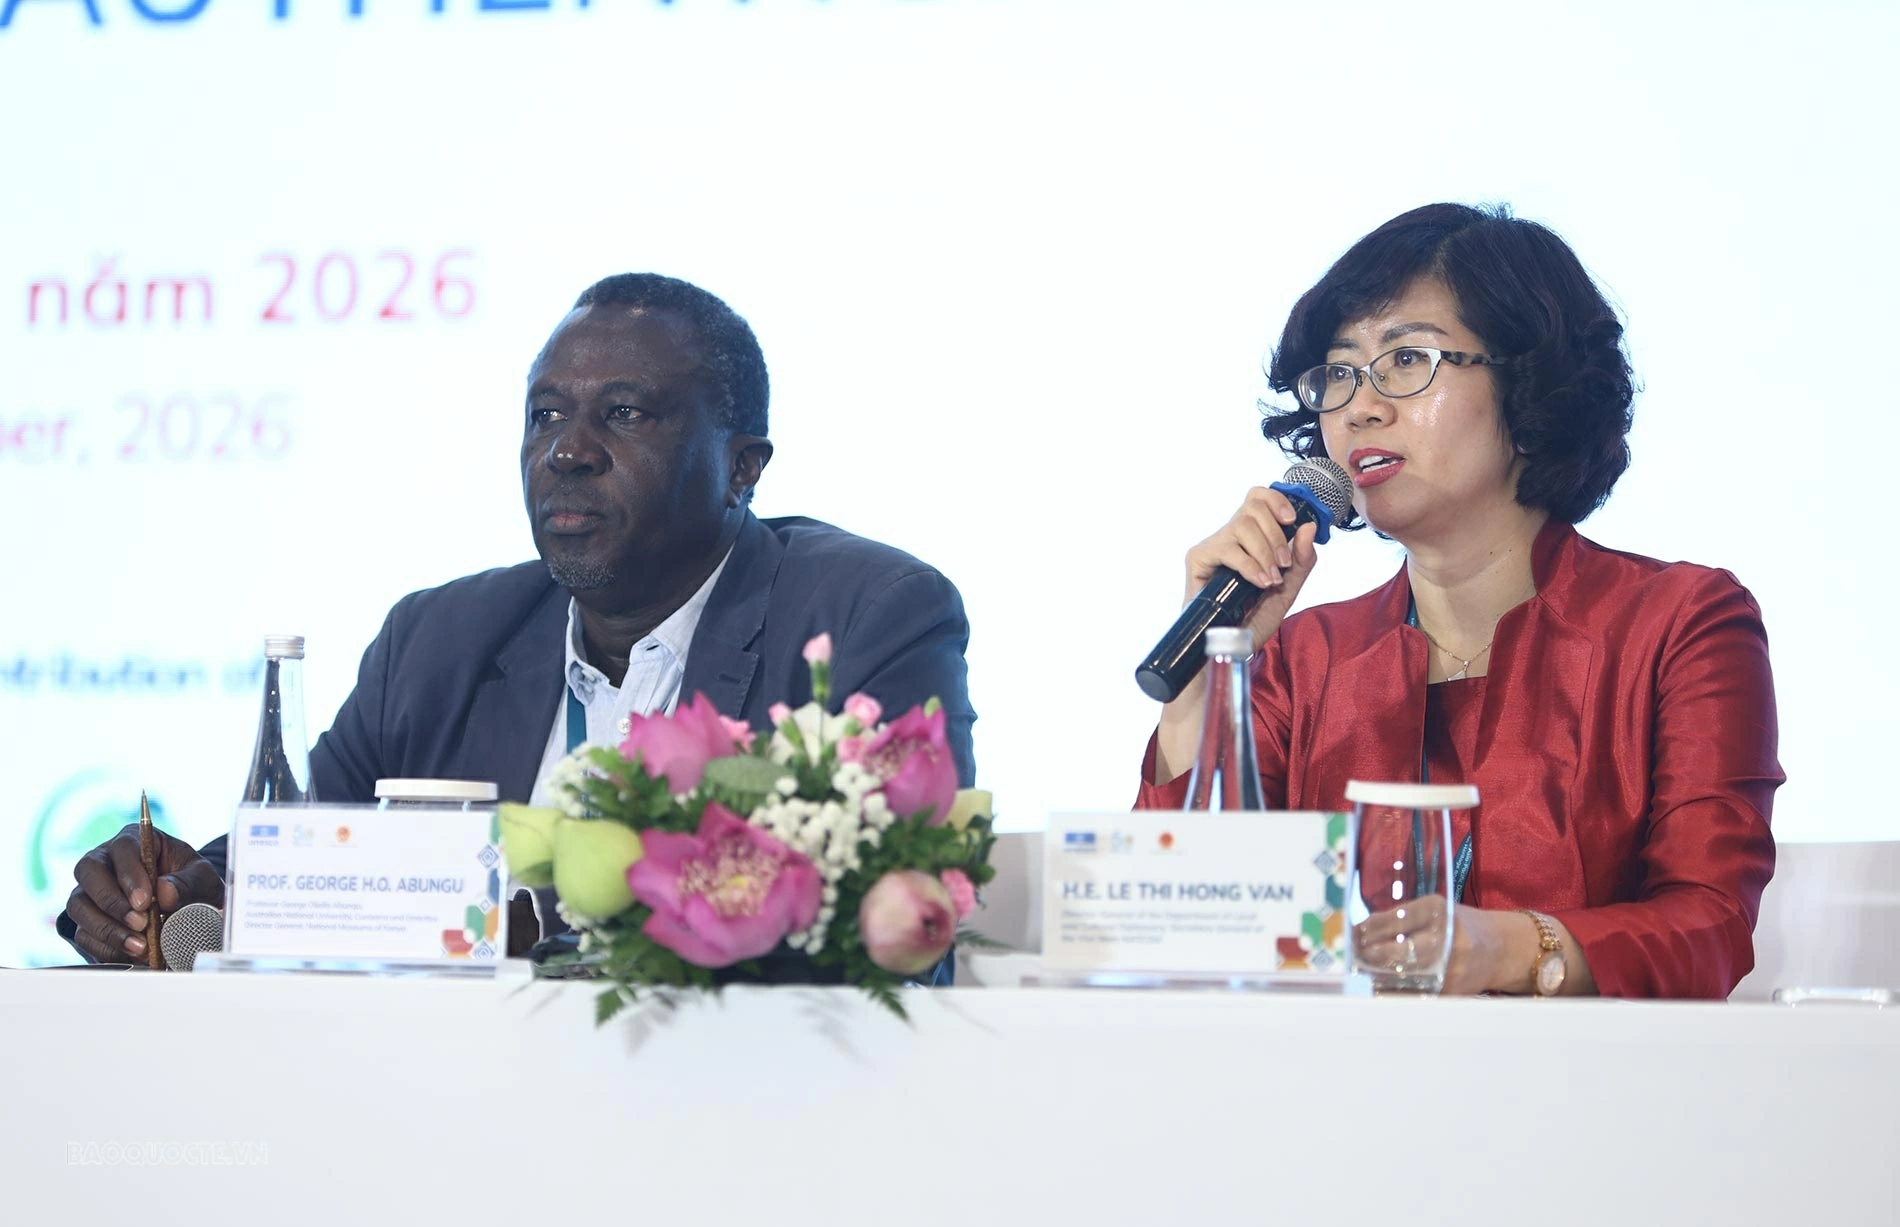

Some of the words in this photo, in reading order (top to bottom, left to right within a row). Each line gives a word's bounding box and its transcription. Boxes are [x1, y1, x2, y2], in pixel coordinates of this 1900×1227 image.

[257, 250, 476, 322] 2026
[0, 408, 88, 464] er,
[116, 391, 293, 462] 2026
[247, 874, 291, 891] PROF.
[295, 875, 358, 892] GEORGE
[363, 877, 392, 893] H.O.
[396, 878, 465, 894] ABUNGU
[1063, 883, 1102, 900] H.E.
[1109, 883, 1131, 900] LE
[1139, 883, 1173, 900] THI
[1179, 883, 1242, 901] HONG
[1248, 884, 1294, 901] VAN
